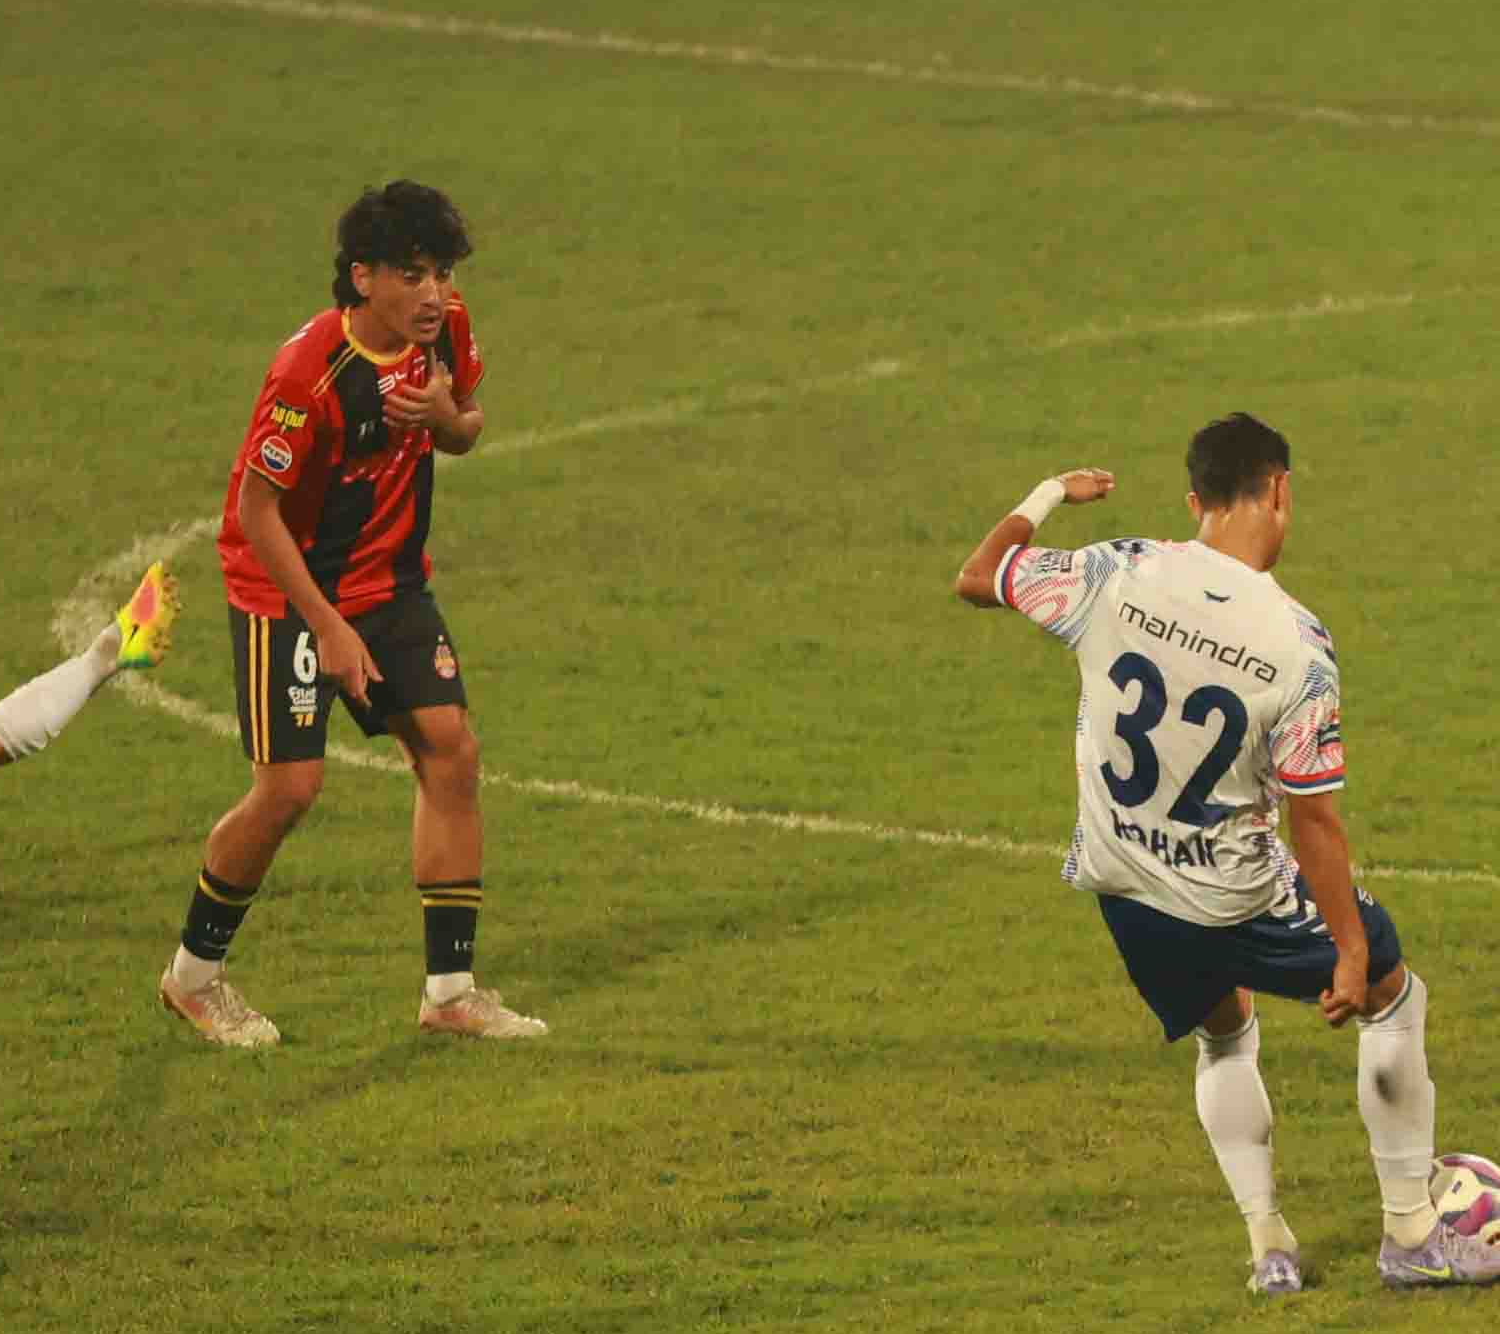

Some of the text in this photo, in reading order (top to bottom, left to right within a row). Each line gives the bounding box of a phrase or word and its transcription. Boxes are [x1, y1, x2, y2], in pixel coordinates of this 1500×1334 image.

[293, 632, 318, 683] 6
[1118, 598, 1278, 685] mahindra
[1100, 650, 1250, 829] 32
